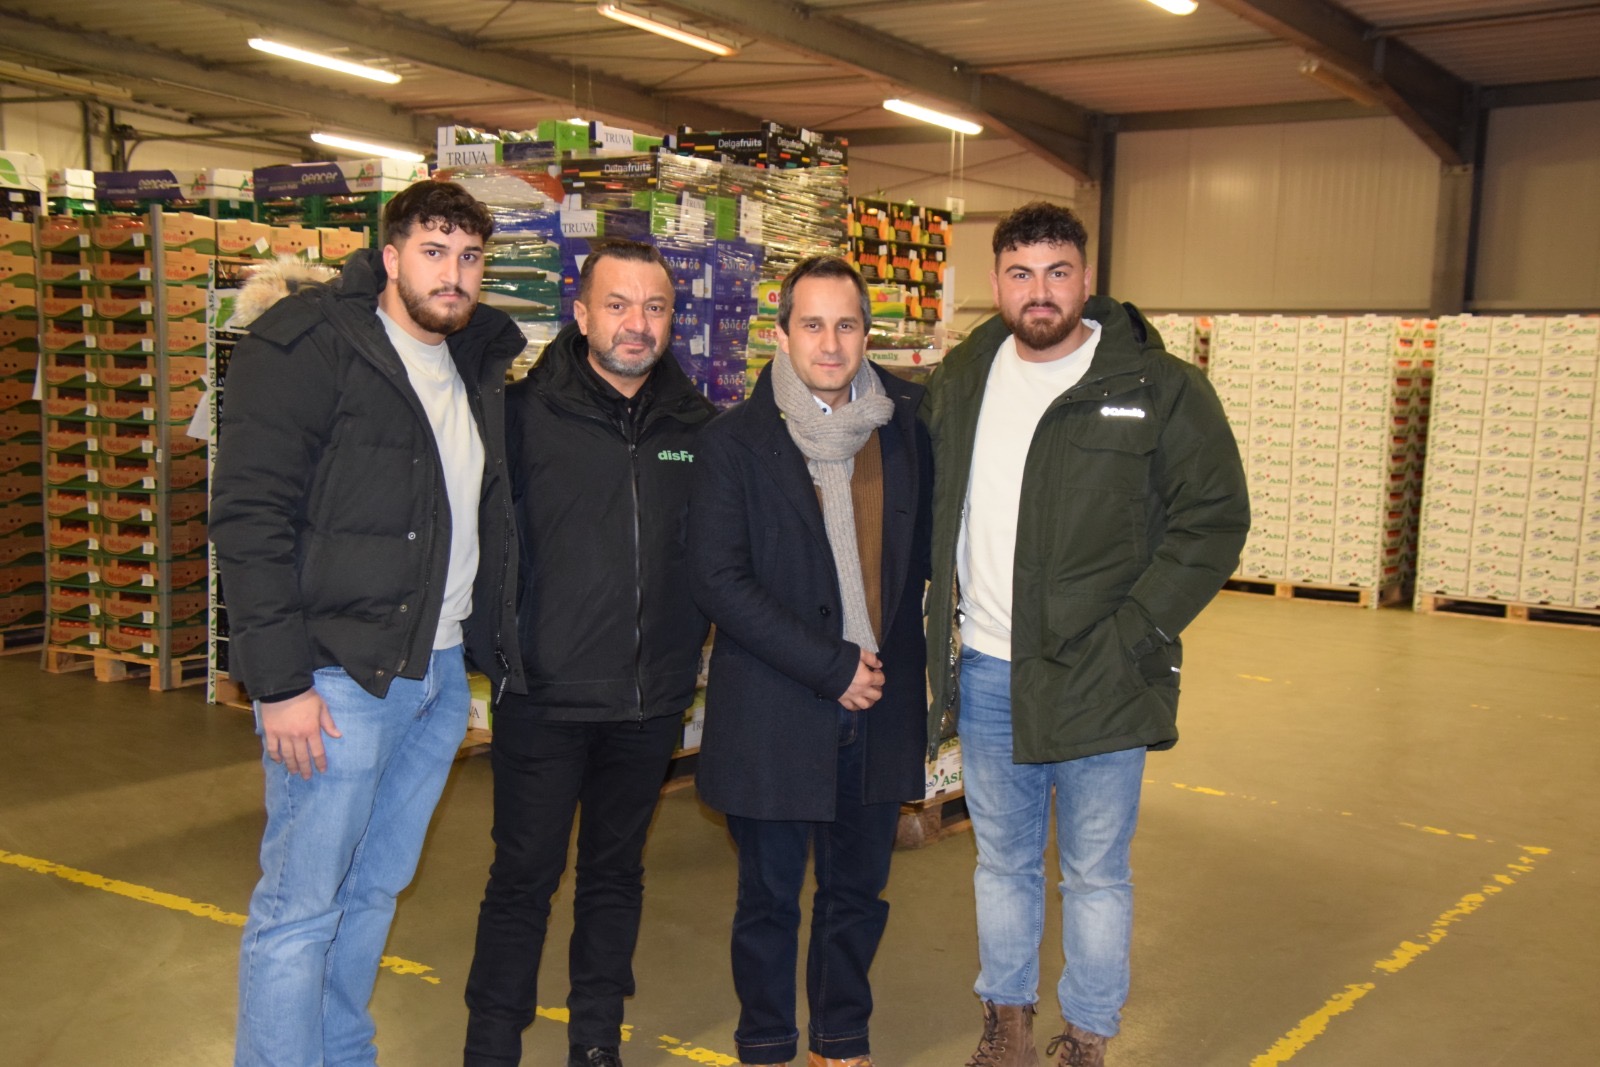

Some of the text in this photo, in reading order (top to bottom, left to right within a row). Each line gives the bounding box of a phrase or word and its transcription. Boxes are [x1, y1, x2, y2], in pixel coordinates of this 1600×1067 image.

[604, 131, 632, 146] TRUVA
[718, 138, 762, 149] Delgafruits
[446, 151, 488, 167] TRUVA
[302, 172, 338, 186] gencer
[562, 222, 596, 234] TRUVA
[872, 352, 898, 361] Family
